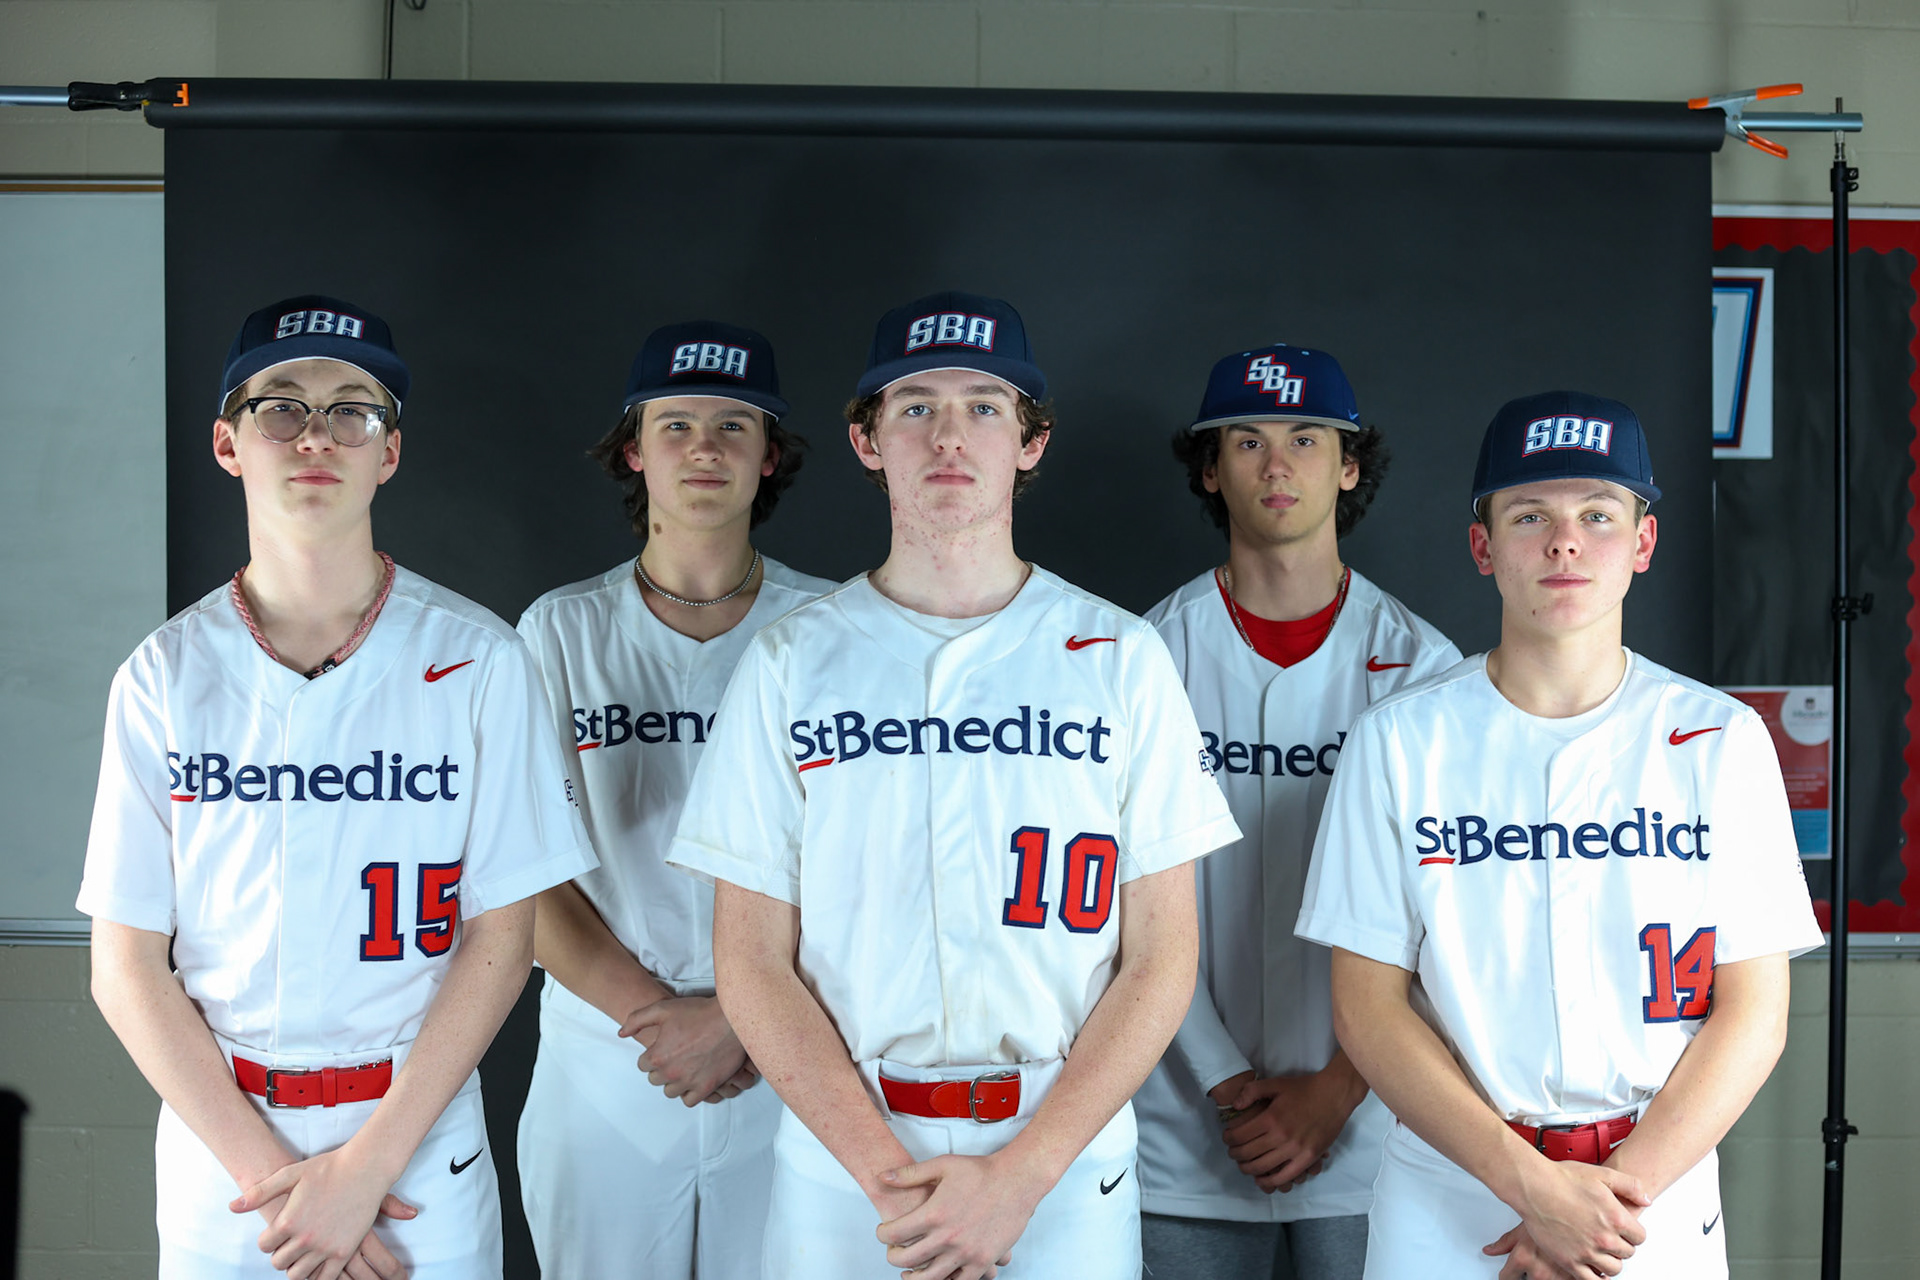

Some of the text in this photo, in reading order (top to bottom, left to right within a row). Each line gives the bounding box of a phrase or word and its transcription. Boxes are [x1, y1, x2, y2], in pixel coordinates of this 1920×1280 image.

[276, 309, 364, 340] SBA
[905, 311, 997, 355] SBA
[670, 341, 749, 379] SBA
[1244, 354, 1307, 407] SBA
[1522, 414, 1613, 457] SBA
[1002, 826, 1119, 934] 10
[360, 859, 462, 962] 15
[1639, 923, 1717, 1024] 14
